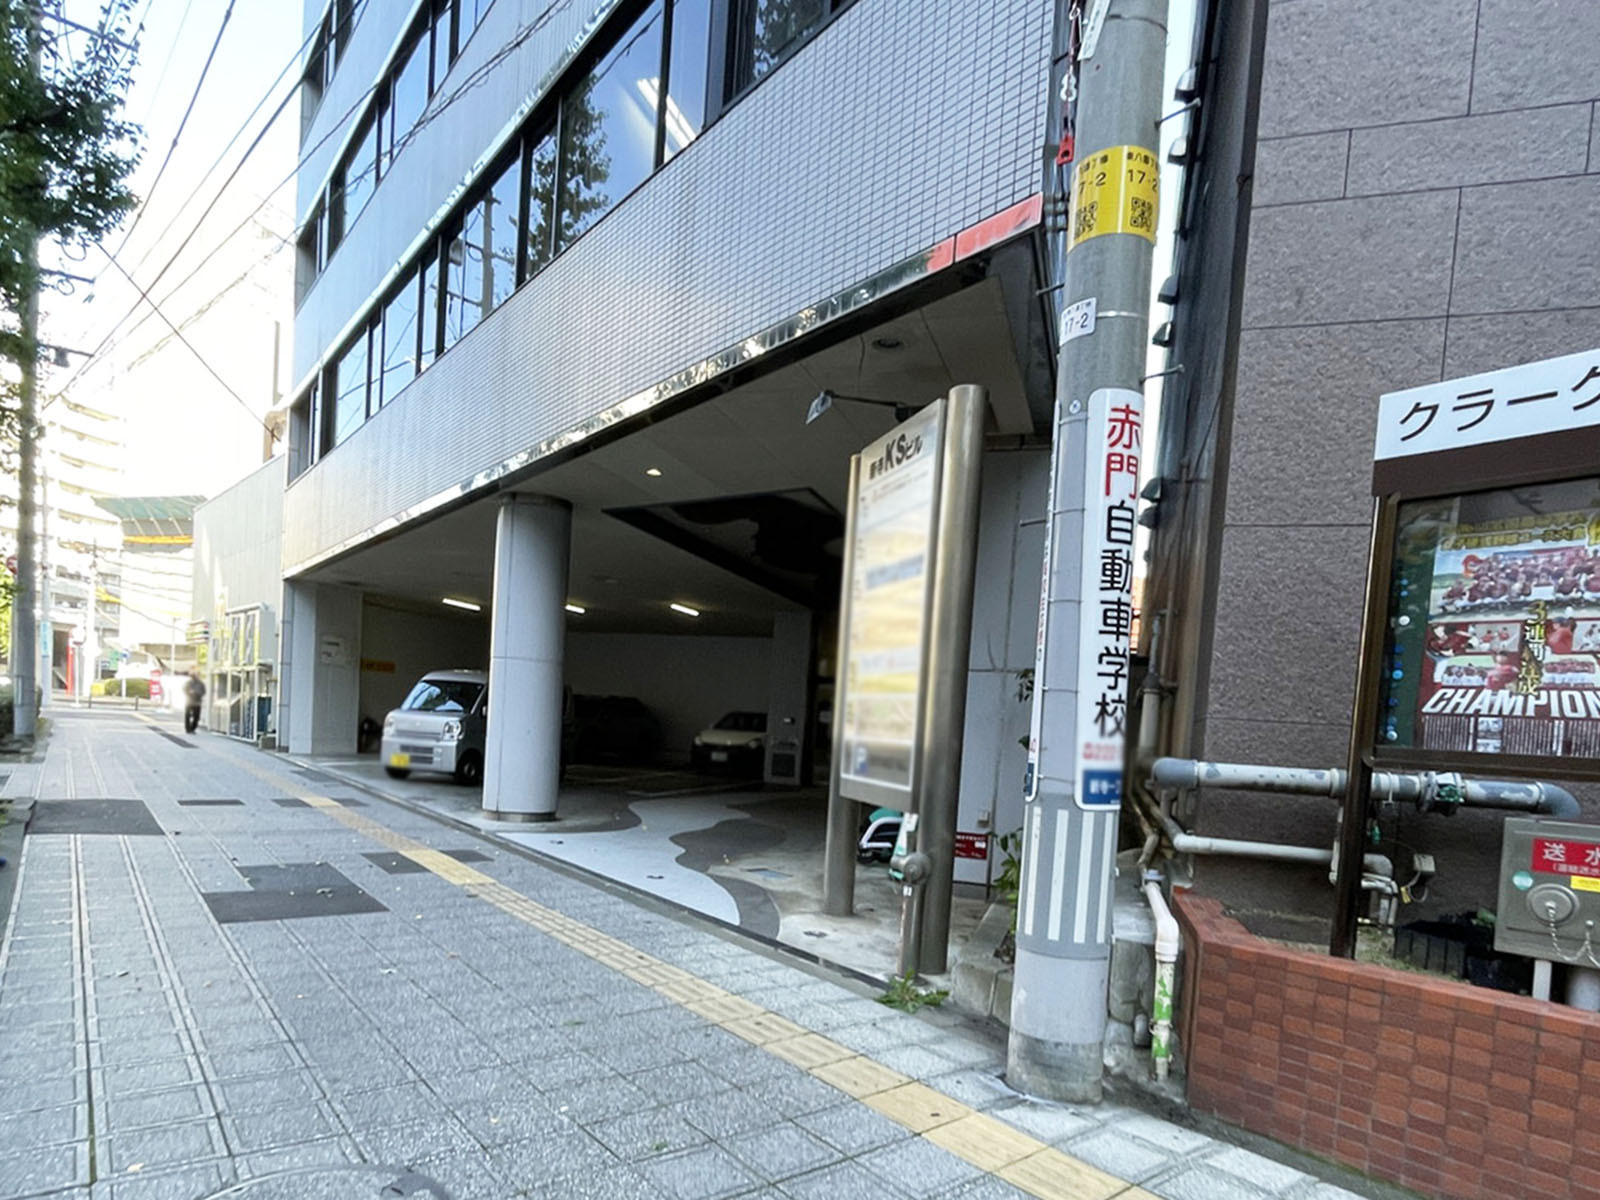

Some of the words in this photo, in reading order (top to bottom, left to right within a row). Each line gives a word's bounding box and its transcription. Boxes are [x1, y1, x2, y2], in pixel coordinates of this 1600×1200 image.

[1093, 403, 1141, 738] 赤門自動車学校
